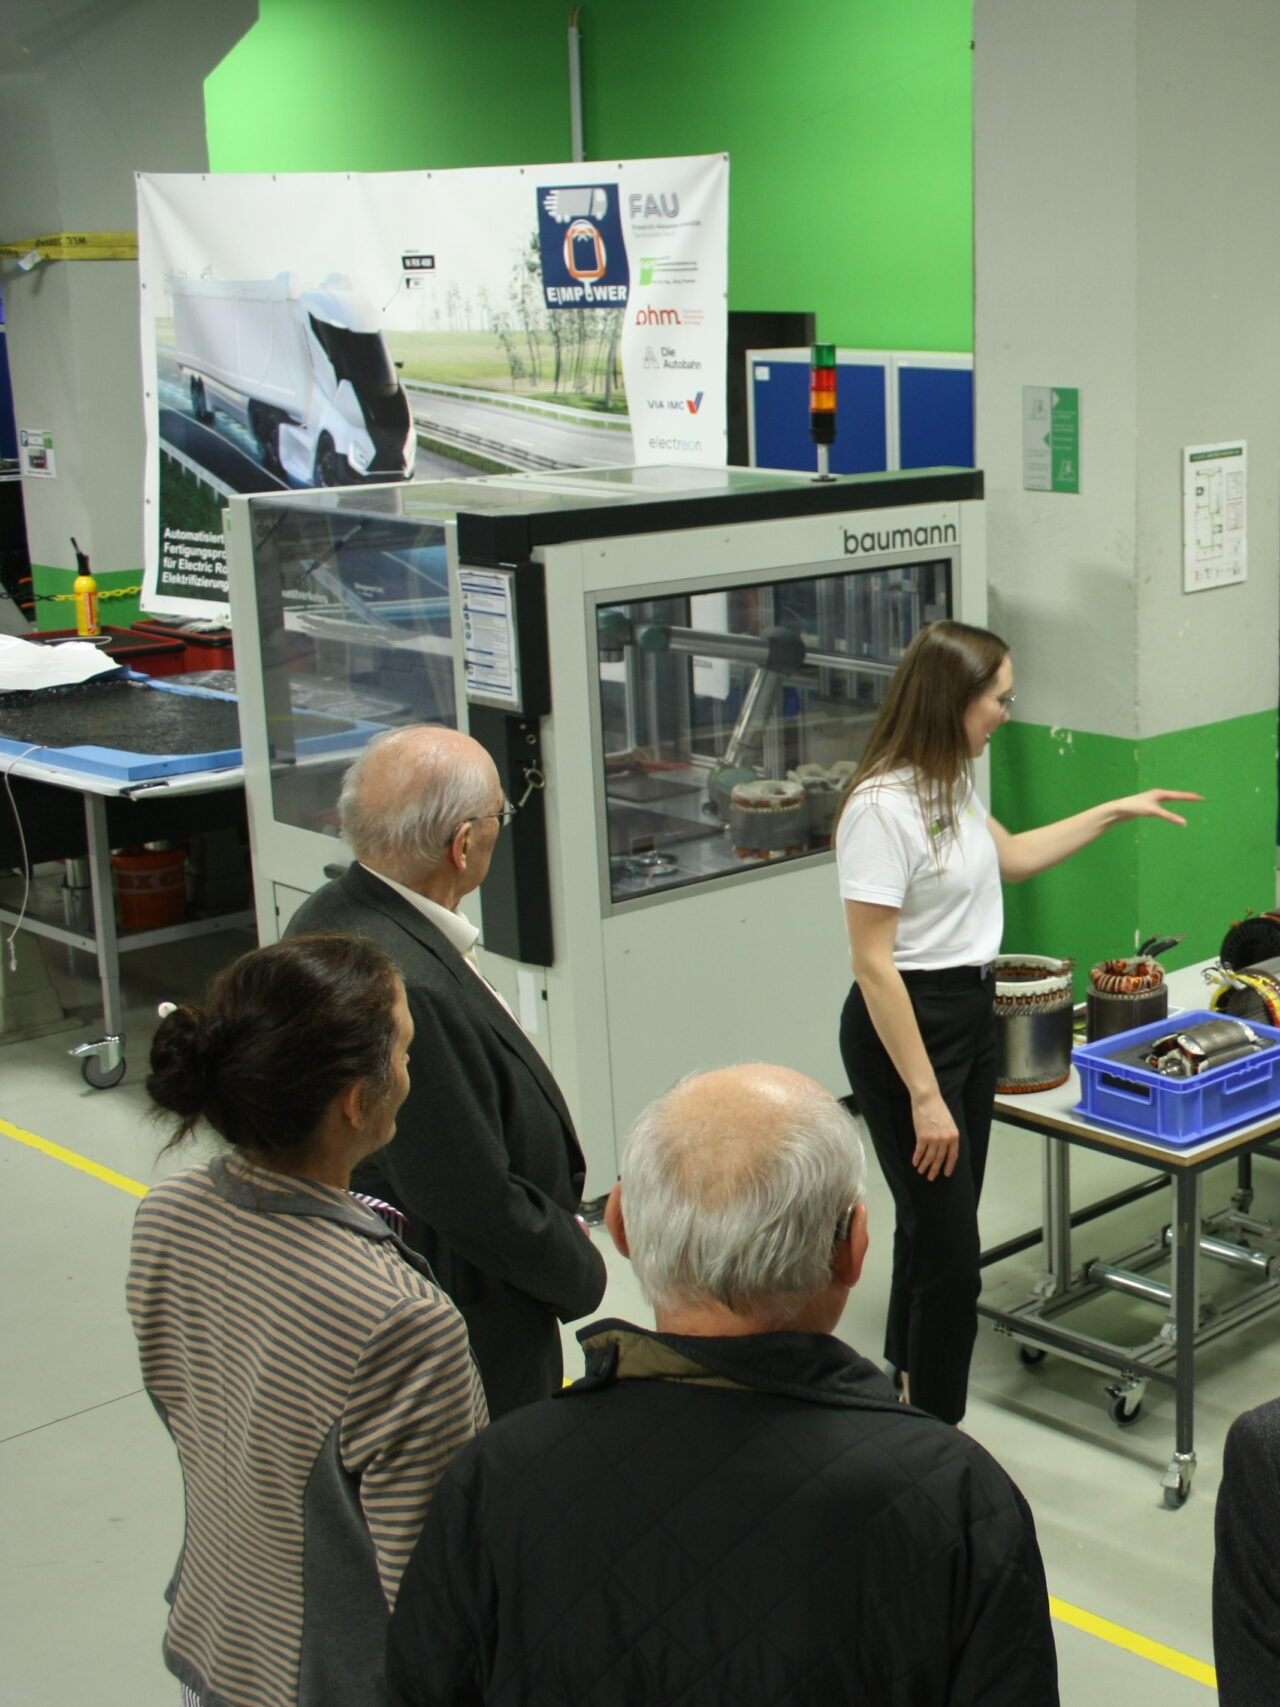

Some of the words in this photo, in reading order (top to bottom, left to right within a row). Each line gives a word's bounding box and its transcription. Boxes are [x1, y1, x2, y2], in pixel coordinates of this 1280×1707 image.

[629, 192, 679, 219] FAU
[661, 346, 676, 357] Die
[663, 359, 702, 370] Autobahn
[647, 400, 664, 409] VIA
[667, 400, 684, 410] IMC
[844, 523, 956, 554] baumann
[164, 558, 176, 569] für
[179, 559, 213, 574] Electric
